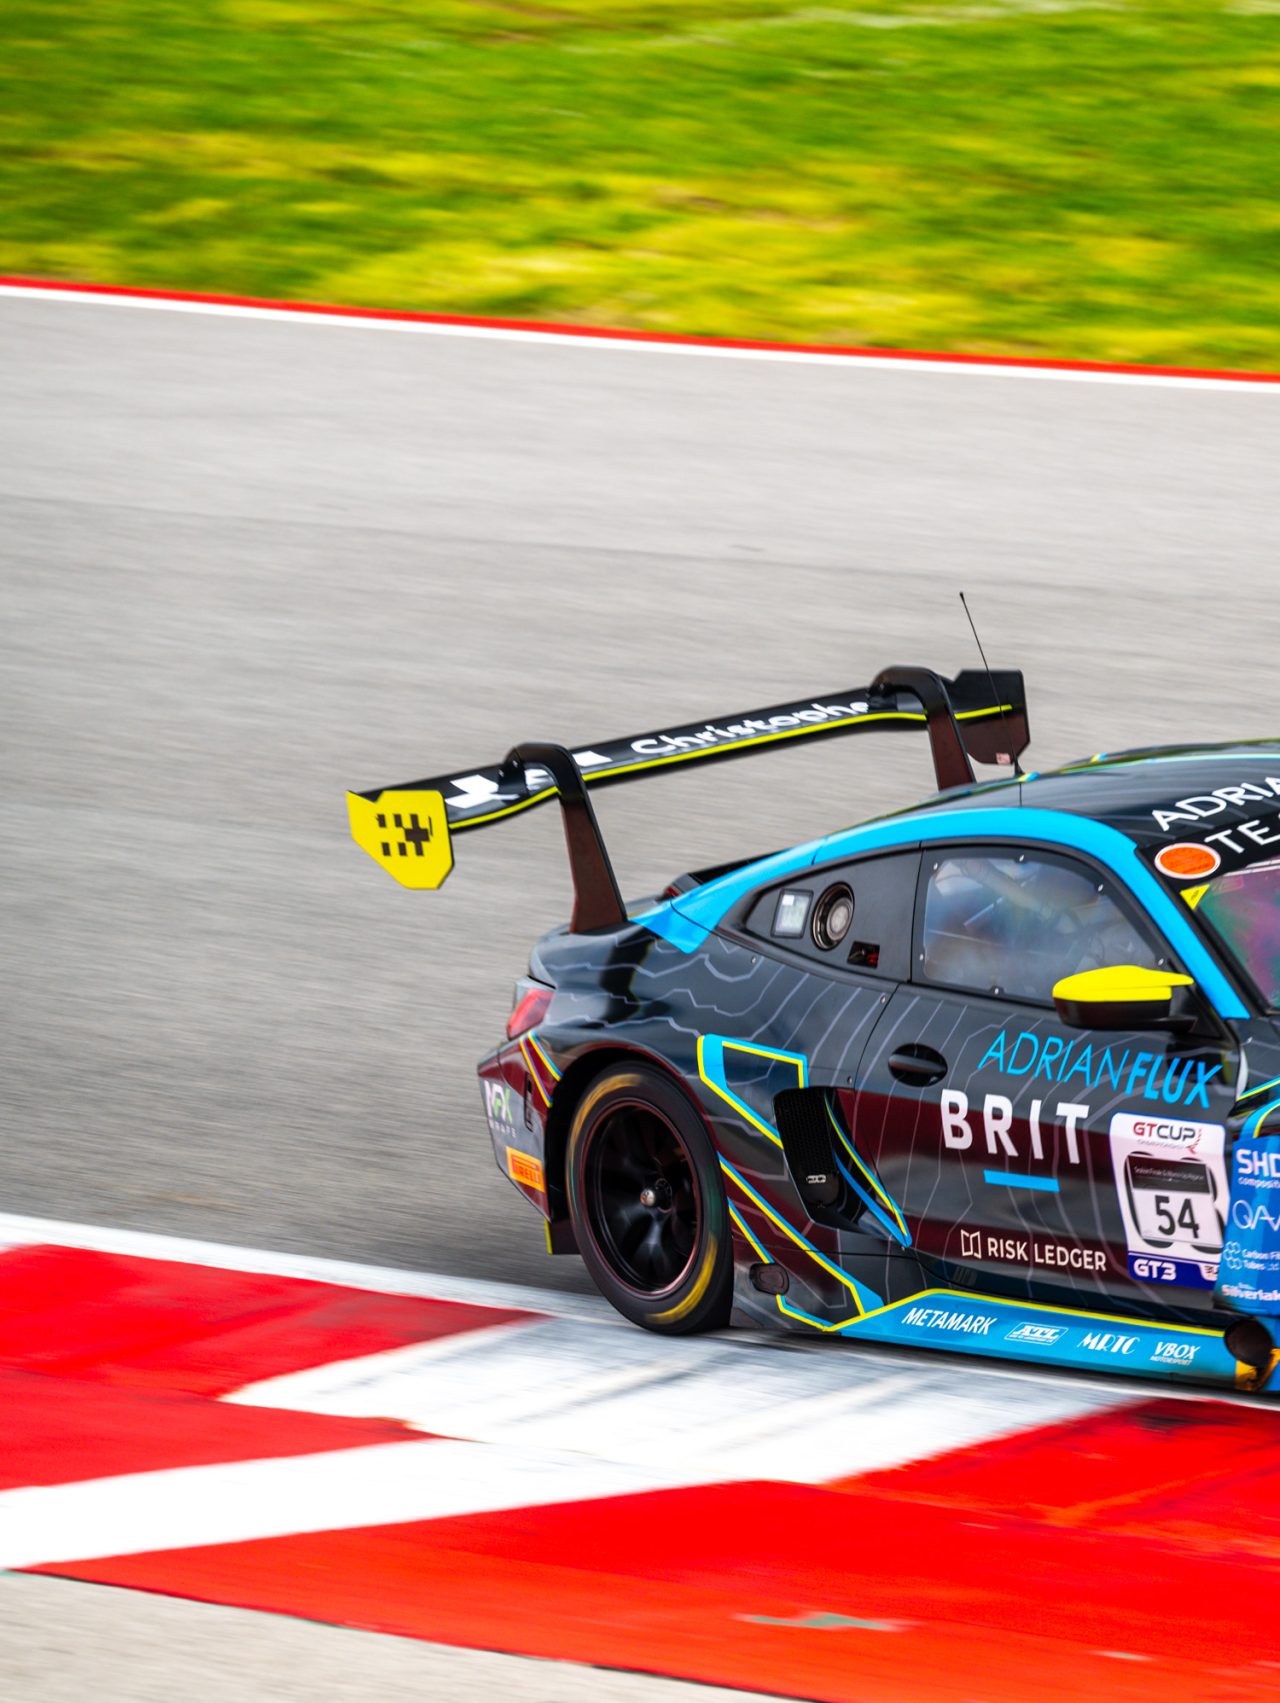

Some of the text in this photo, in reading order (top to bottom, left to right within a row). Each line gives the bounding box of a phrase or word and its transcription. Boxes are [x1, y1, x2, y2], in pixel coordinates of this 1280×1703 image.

[940, 1088, 1090, 1165] BRIT
[1133, 1121, 1197, 1143] GTCUP
[1155, 1194, 1200, 1239] 54
[988, 1236, 1107, 1272] RISK LEDGER
[1133, 1258, 1177, 1281] GT3
[901, 1307, 998, 1336] METAMARK
[1154, 1341, 1201, 1360] VBOX
